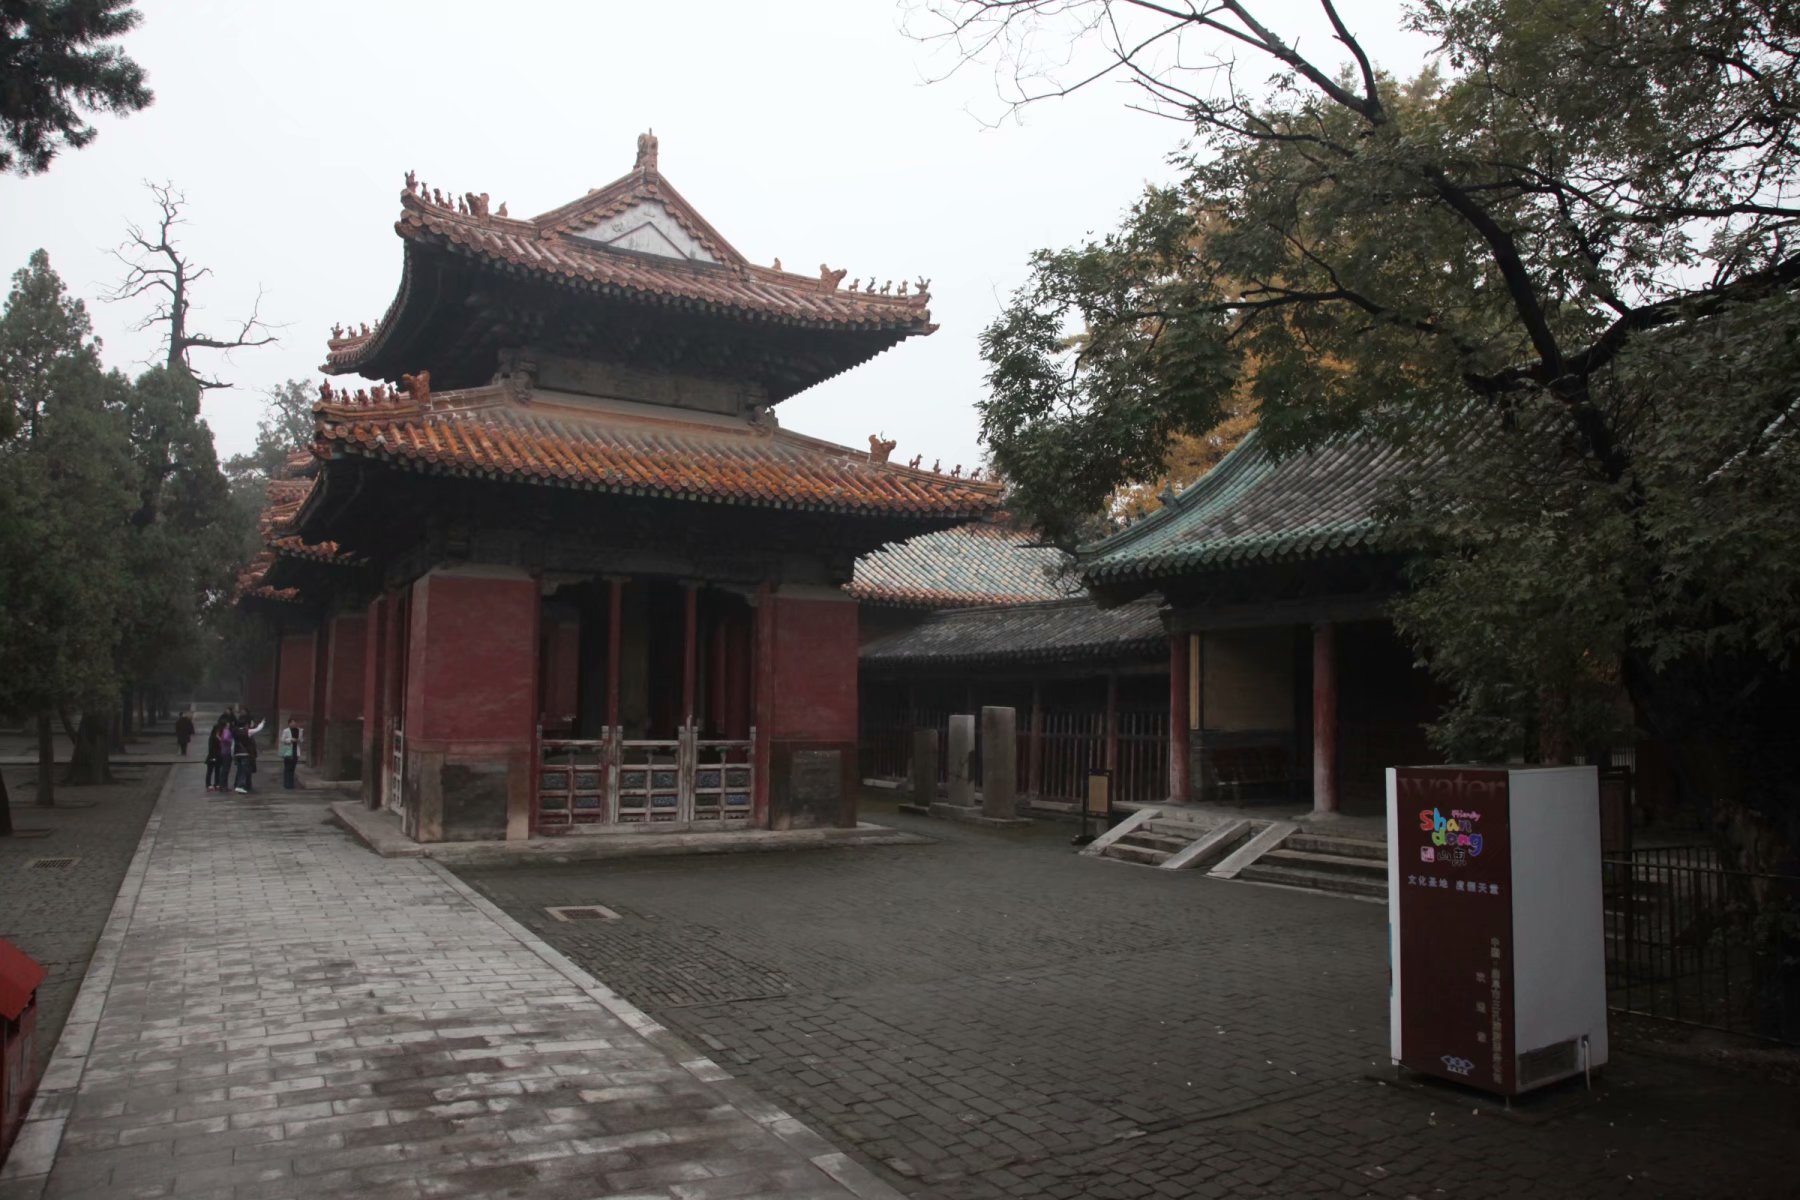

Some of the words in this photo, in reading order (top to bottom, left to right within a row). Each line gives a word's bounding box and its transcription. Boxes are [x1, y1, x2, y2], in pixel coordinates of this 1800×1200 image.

[1399, 771, 1506, 799] water
[1408, 875, 1448, 889] 文化圣地
